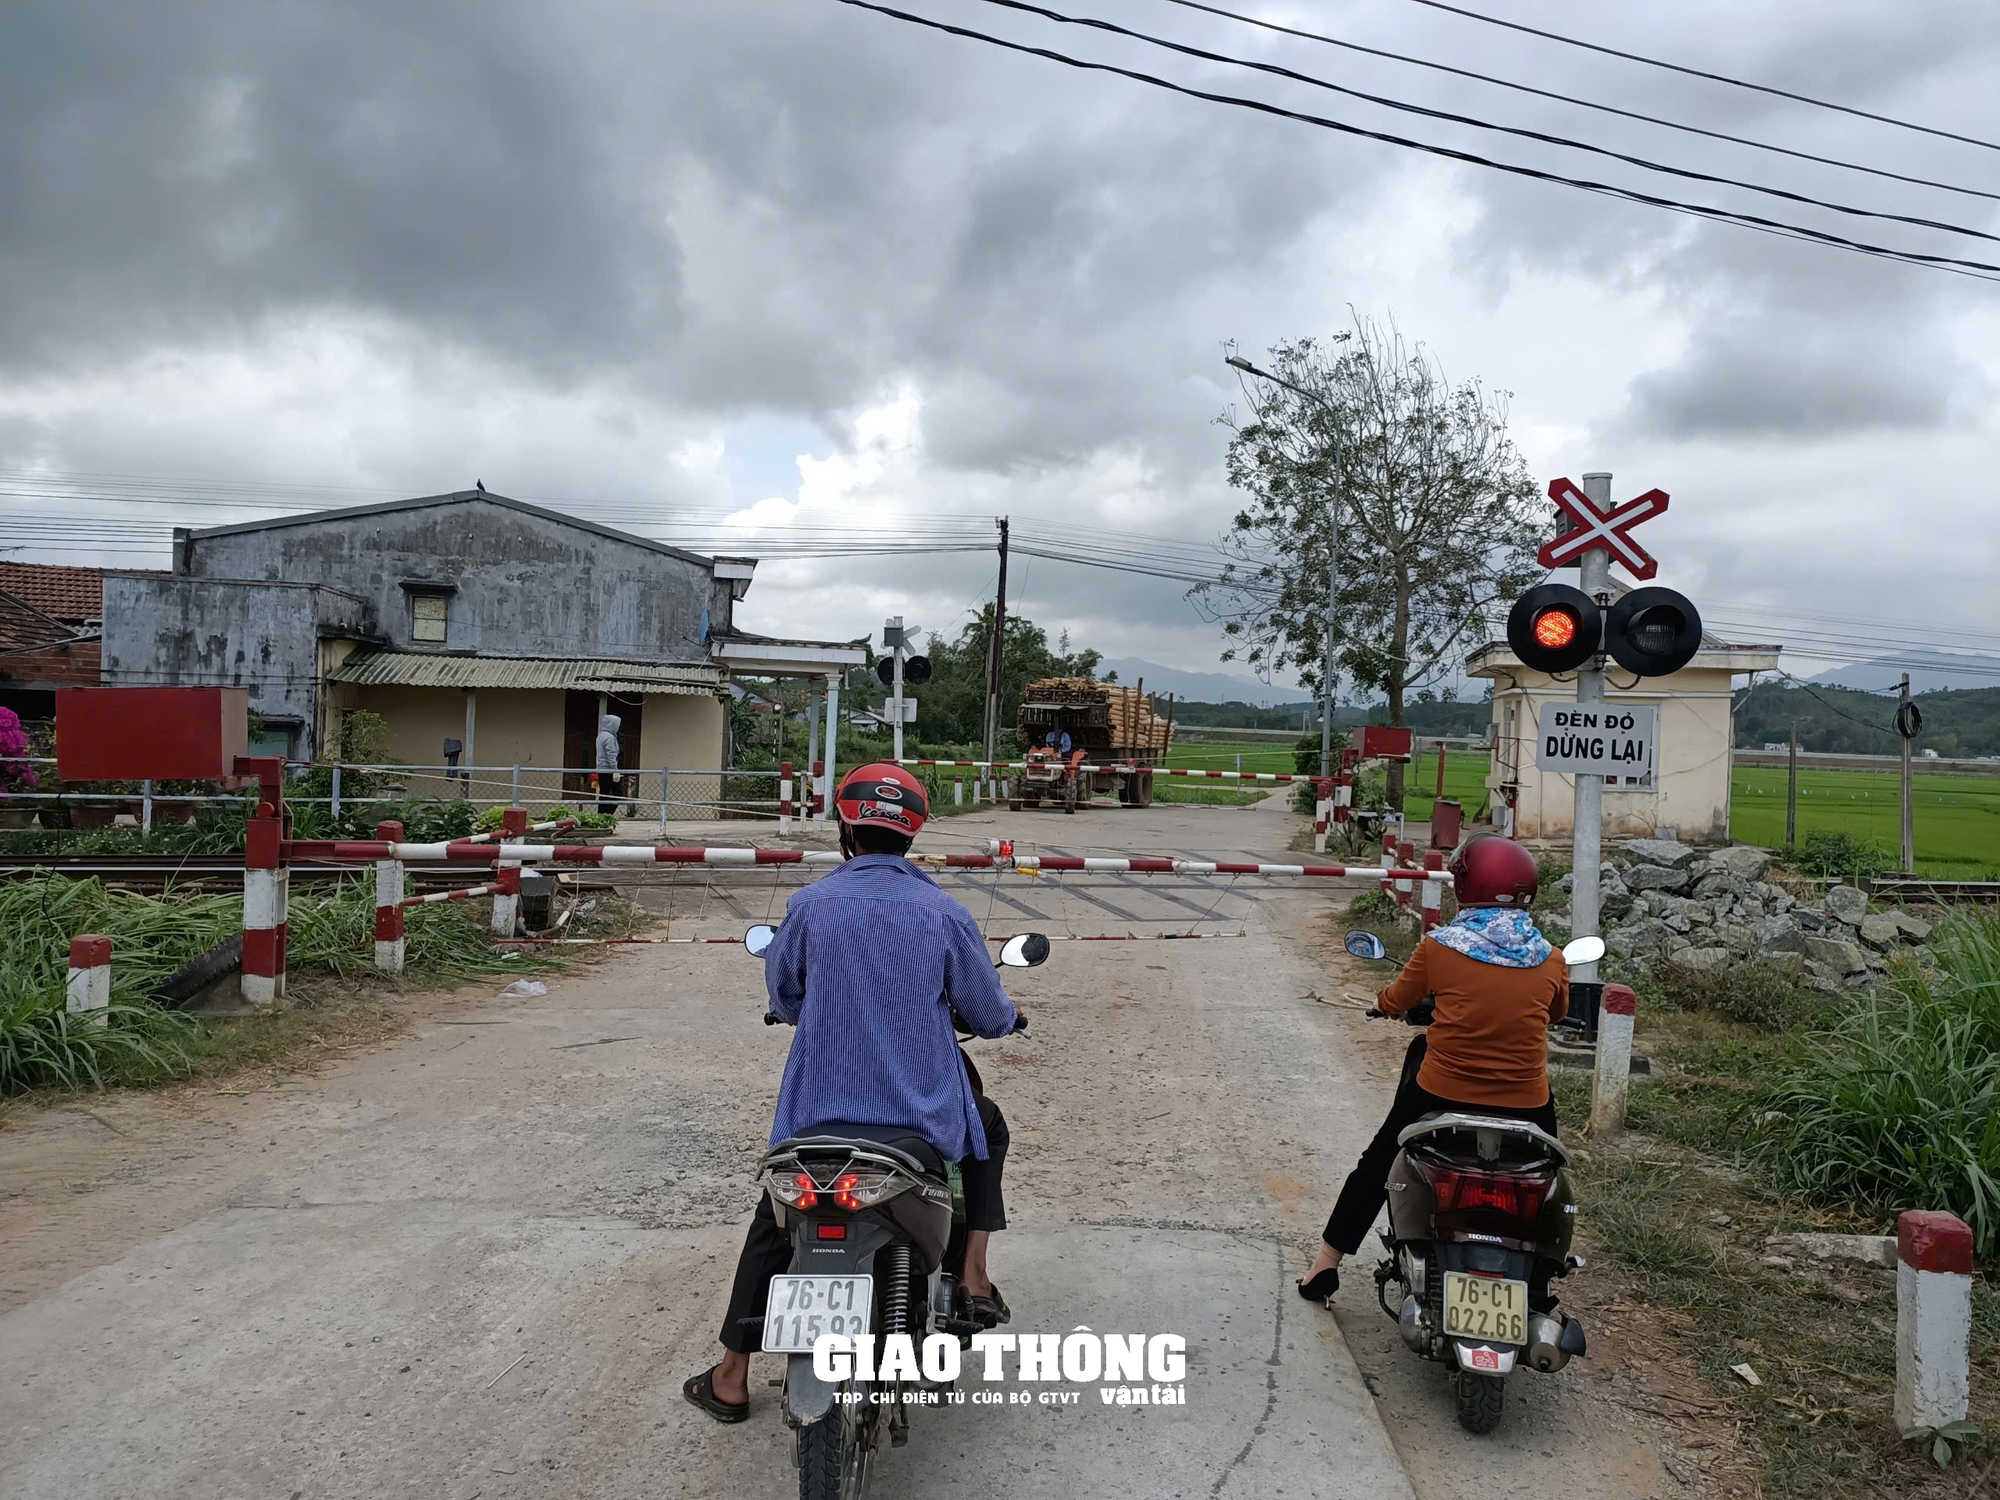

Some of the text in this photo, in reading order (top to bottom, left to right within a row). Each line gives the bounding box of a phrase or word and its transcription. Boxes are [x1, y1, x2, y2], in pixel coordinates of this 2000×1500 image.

[1555, 709, 1635, 732] ĐÈN ĐỎ
[1546, 733, 1643, 764] DỪNG LẠI
[858, 801, 911, 826] Vespa
[1469, 1232, 1503, 1243] HONDA
[786, 1279, 856, 1310] 76-C1
[1456, 1278, 1512, 1310] 76-C1
[1449, 1306, 1522, 1340] 022.66
